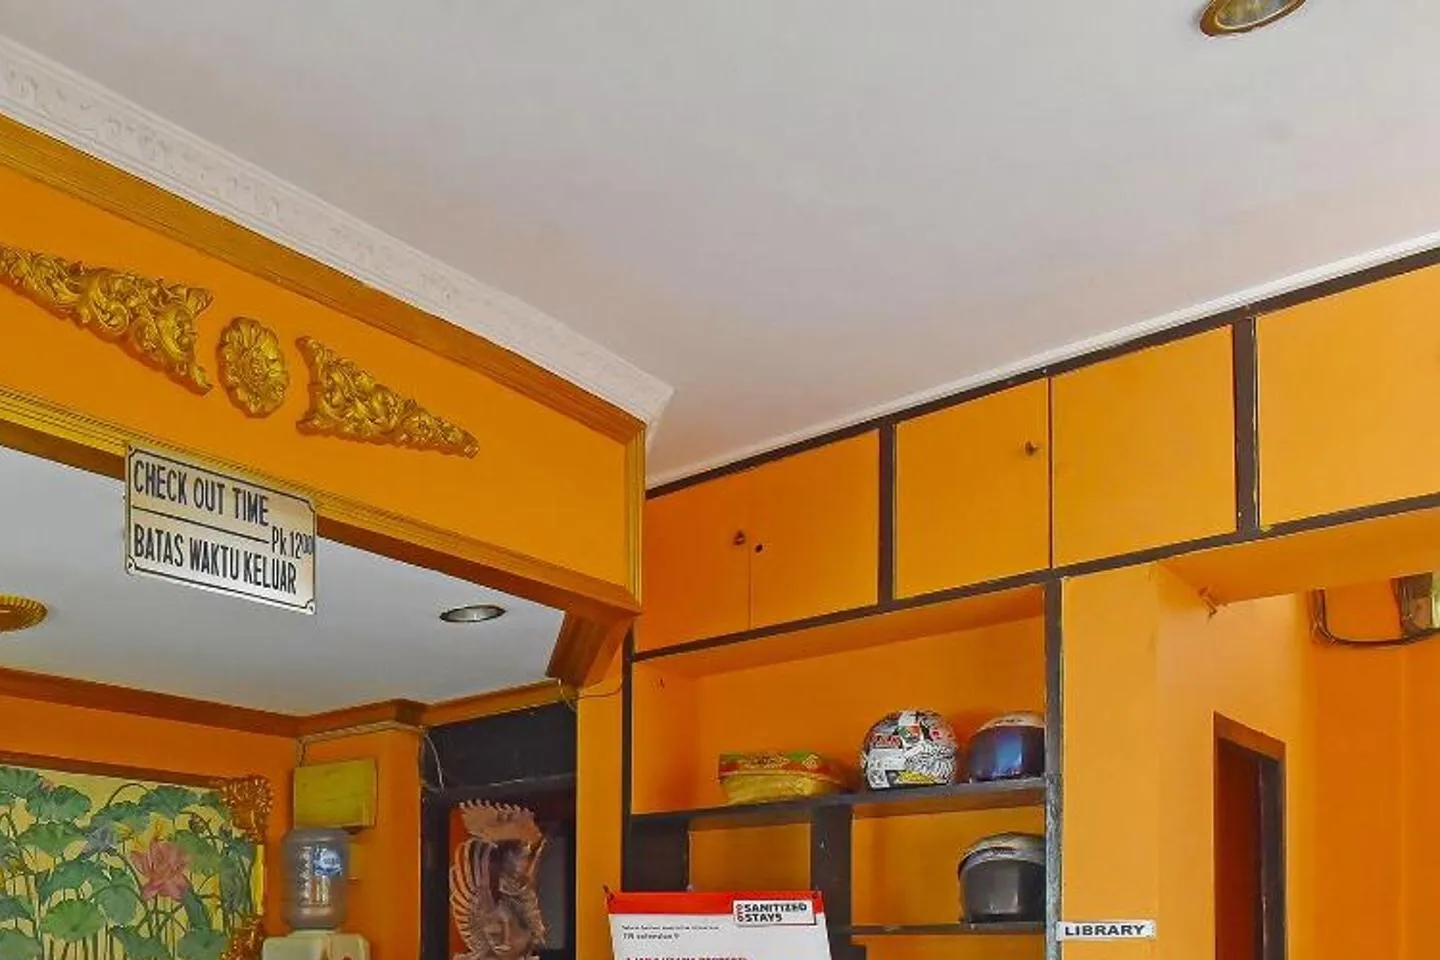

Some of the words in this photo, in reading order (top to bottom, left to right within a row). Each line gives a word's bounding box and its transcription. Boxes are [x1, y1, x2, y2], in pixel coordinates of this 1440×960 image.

[133, 459, 188, 505] CHECK
[193, 477, 226, 515] OUT
[232, 486, 269, 526] TIME
[133, 523, 184, 567] BATAS
[189, 536, 240, 580] WAKTU
[243, 552, 298, 594] KELUAR
[744, 902, 808, 913] SANITIZED
[744, 913, 783, 922] STAYS
[1064, 924, 1146, 937] LIBRARY
